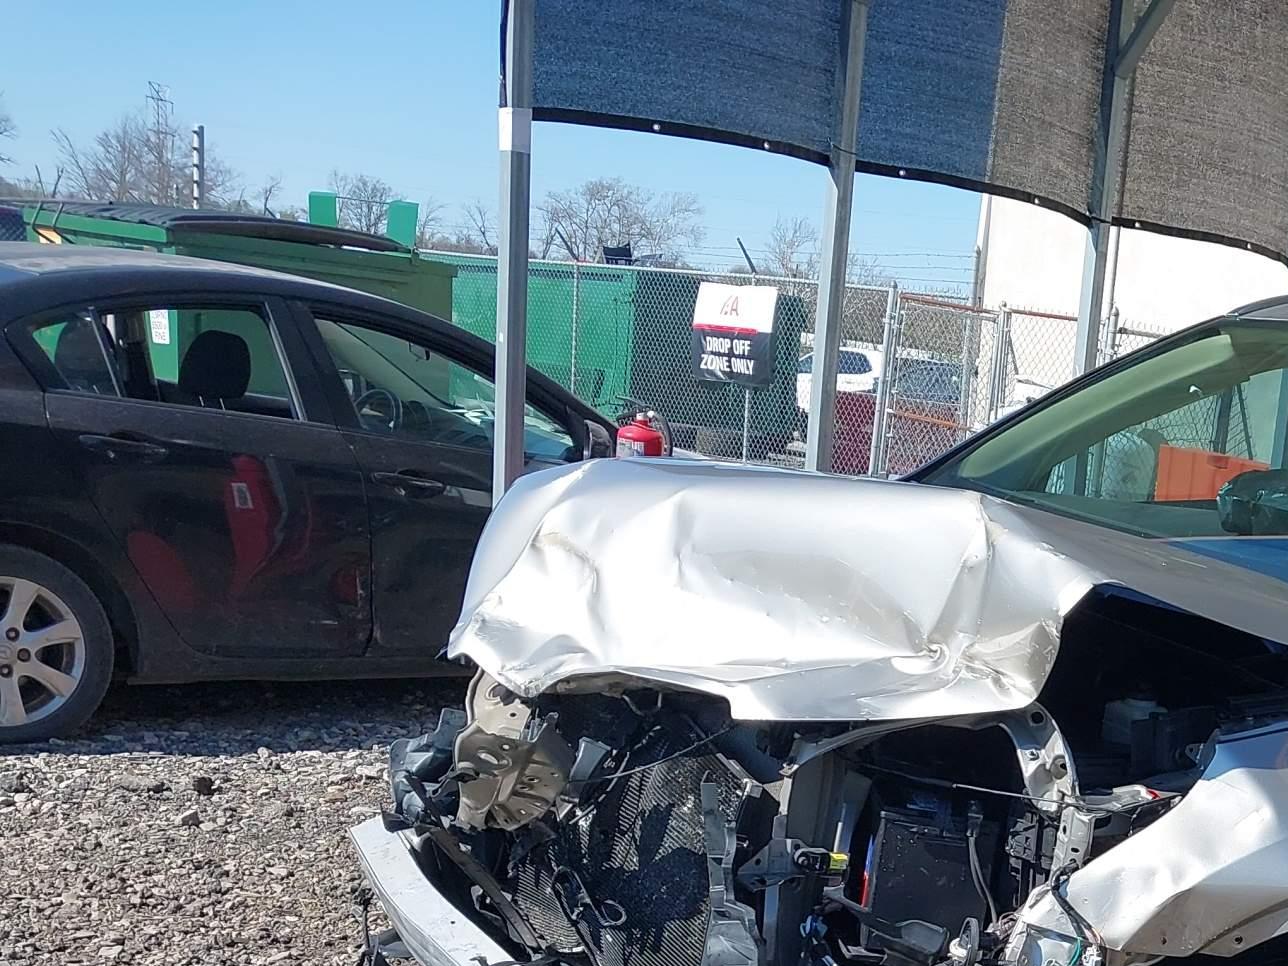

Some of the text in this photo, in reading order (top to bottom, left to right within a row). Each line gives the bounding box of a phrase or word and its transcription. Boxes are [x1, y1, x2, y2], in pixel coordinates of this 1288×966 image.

[705, 336, 751, 356] DROP OFF
[700, 354, 754, 375] ZONE ONLY
